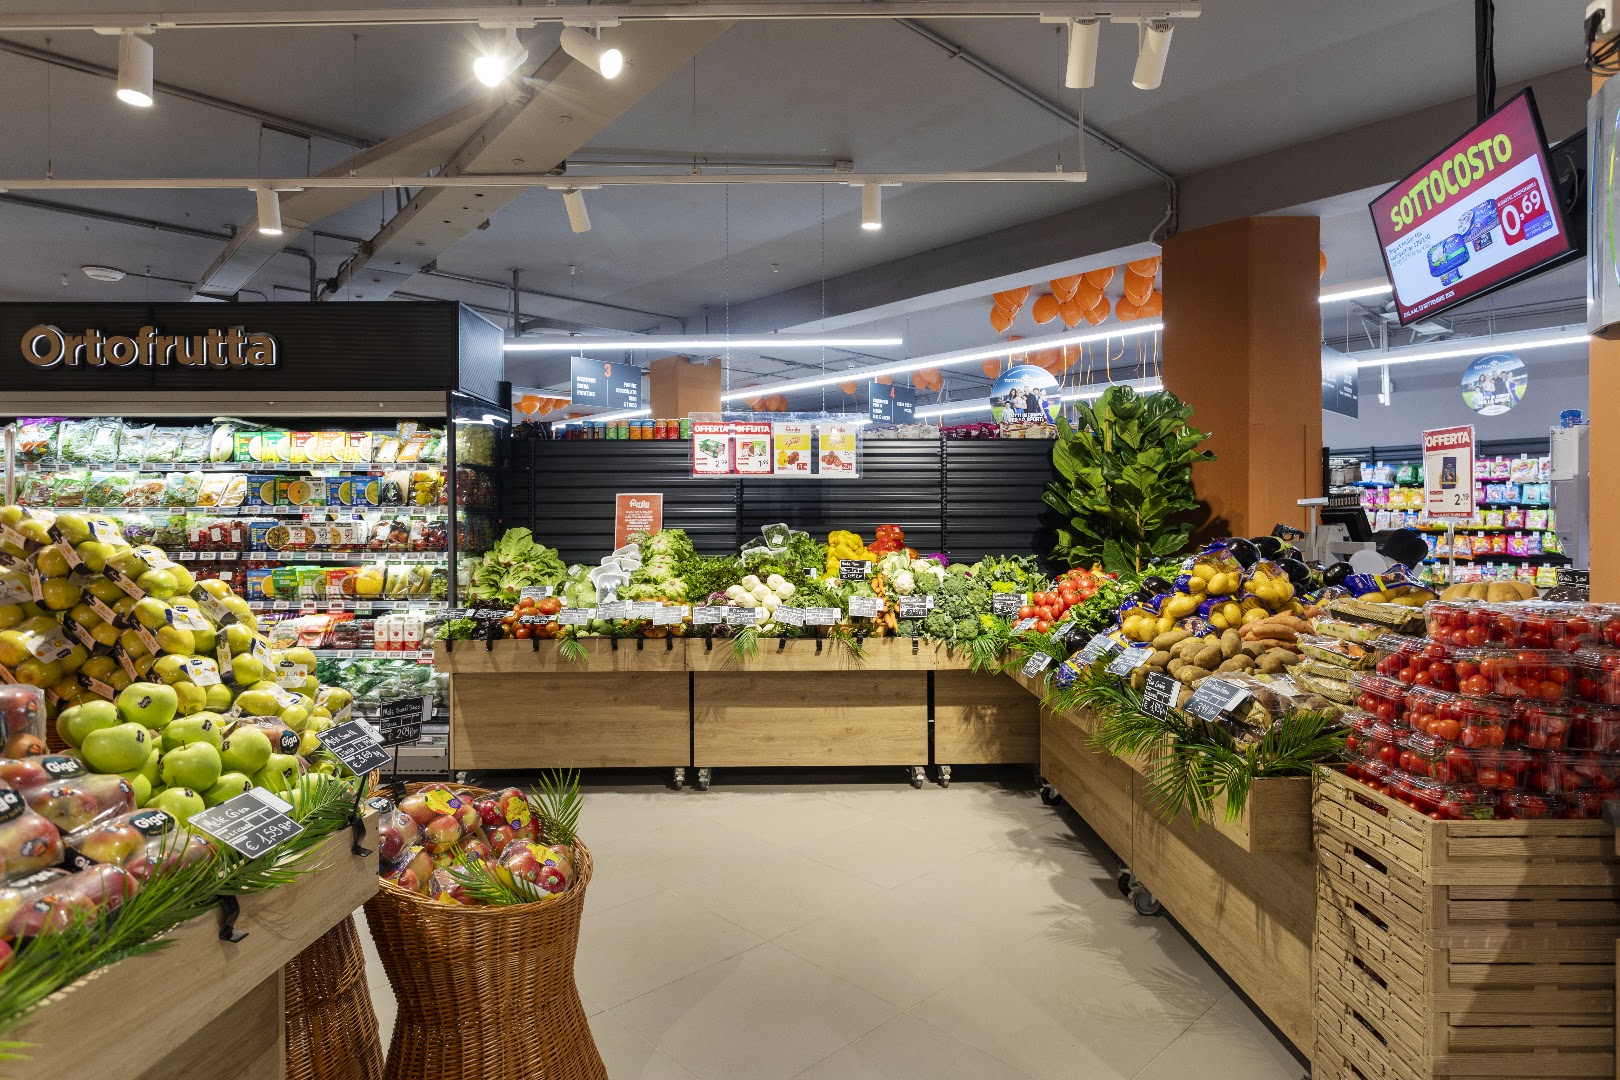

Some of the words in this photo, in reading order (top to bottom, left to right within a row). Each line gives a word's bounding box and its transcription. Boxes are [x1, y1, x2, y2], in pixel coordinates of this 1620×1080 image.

[1390, 133, 1512, 232] SOTTOCOSTO
[1502, 190, 1540, 236] 0,69
[21, 325, 278, 367] Ortofrutta
[604, 363, 611, 378] 3
[890, 386, 896, 399] 4
[694, 425, 729, 433] OFFERTA
[735, 425, 771, 433] OFFERTA
[1426, 431, 1471, 448] OFFERTA
[281, 735, 298, 747] Giga
[46, 759, 79, 773] Giga
[134, 811, 169, 829] Giga
